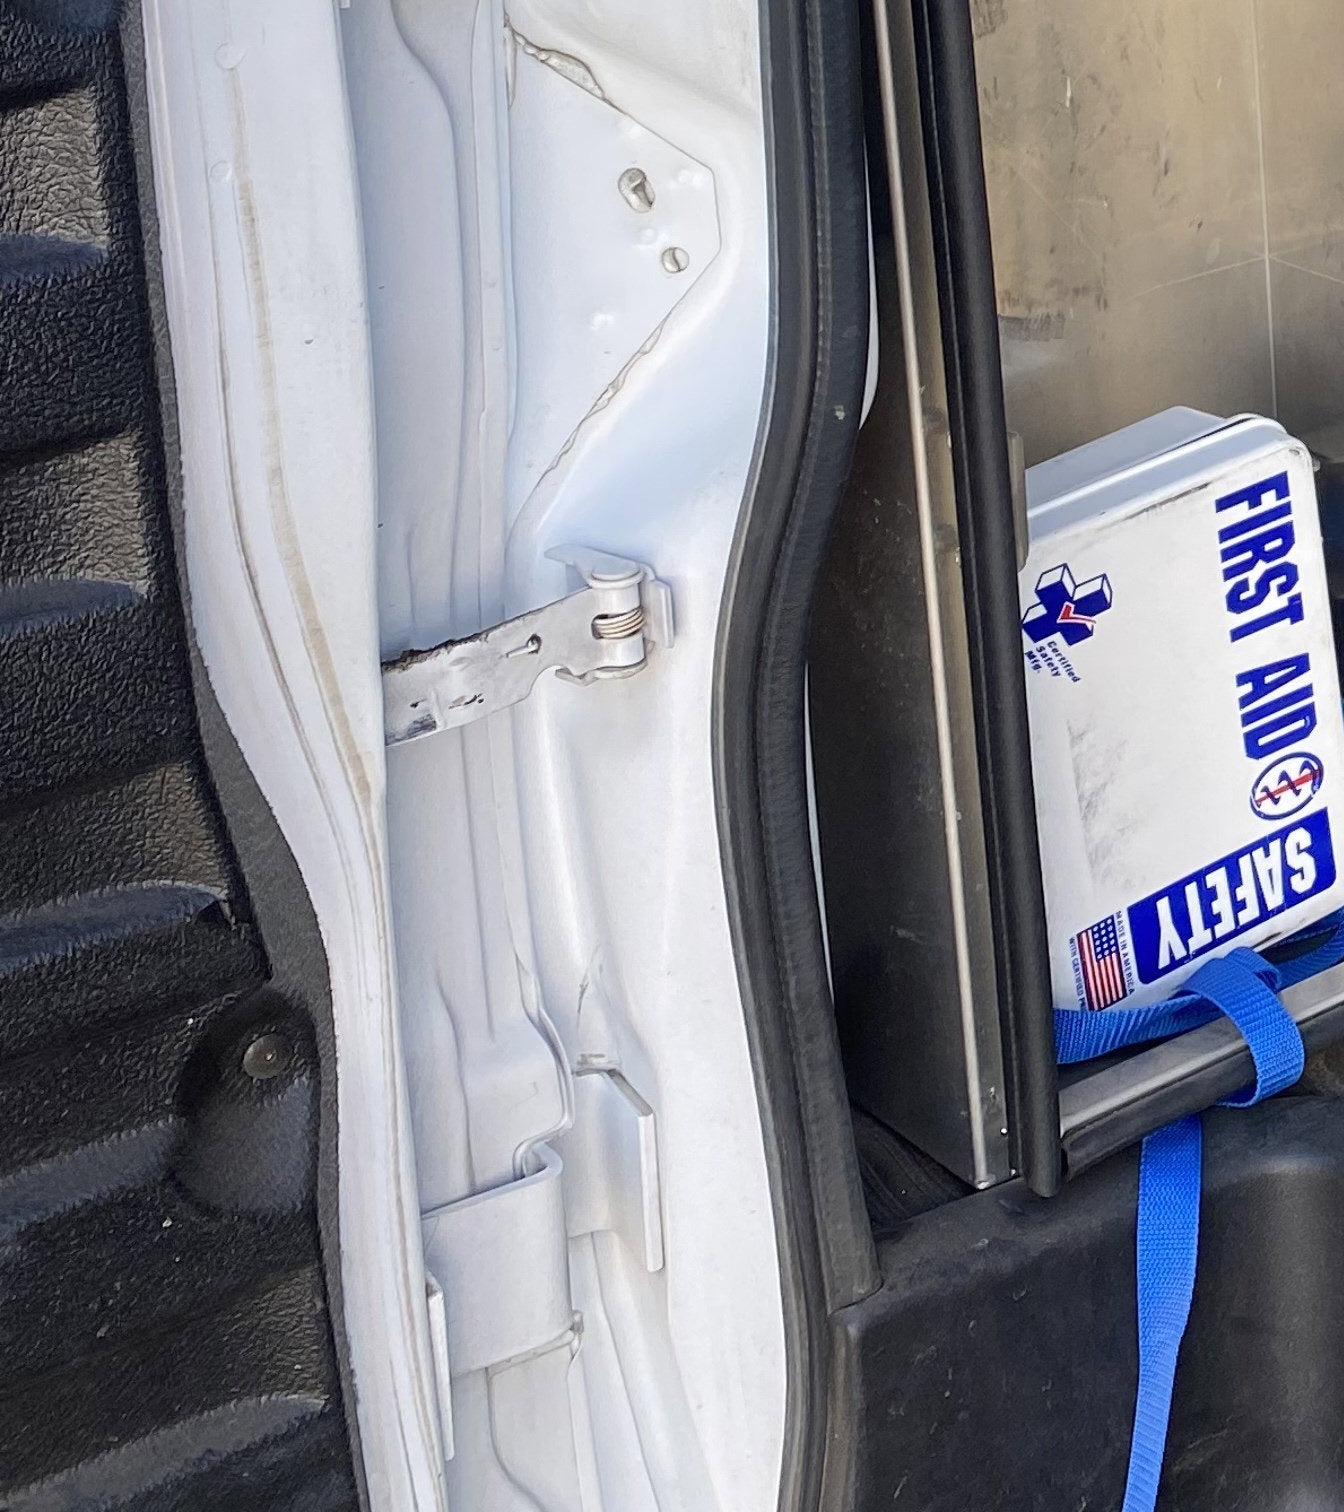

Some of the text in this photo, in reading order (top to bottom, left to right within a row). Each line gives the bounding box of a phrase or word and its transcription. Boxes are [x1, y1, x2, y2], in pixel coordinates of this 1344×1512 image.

[1215, 470, 1317, 760] FIRST AID
[1036, 646, 1061, 677] Safety
[1047, 641, 1081, 683] Certified
[1156, 827, 1317, 970] SAFETY
[1115, 910, 1135, 995] MADE IN AMERICA
